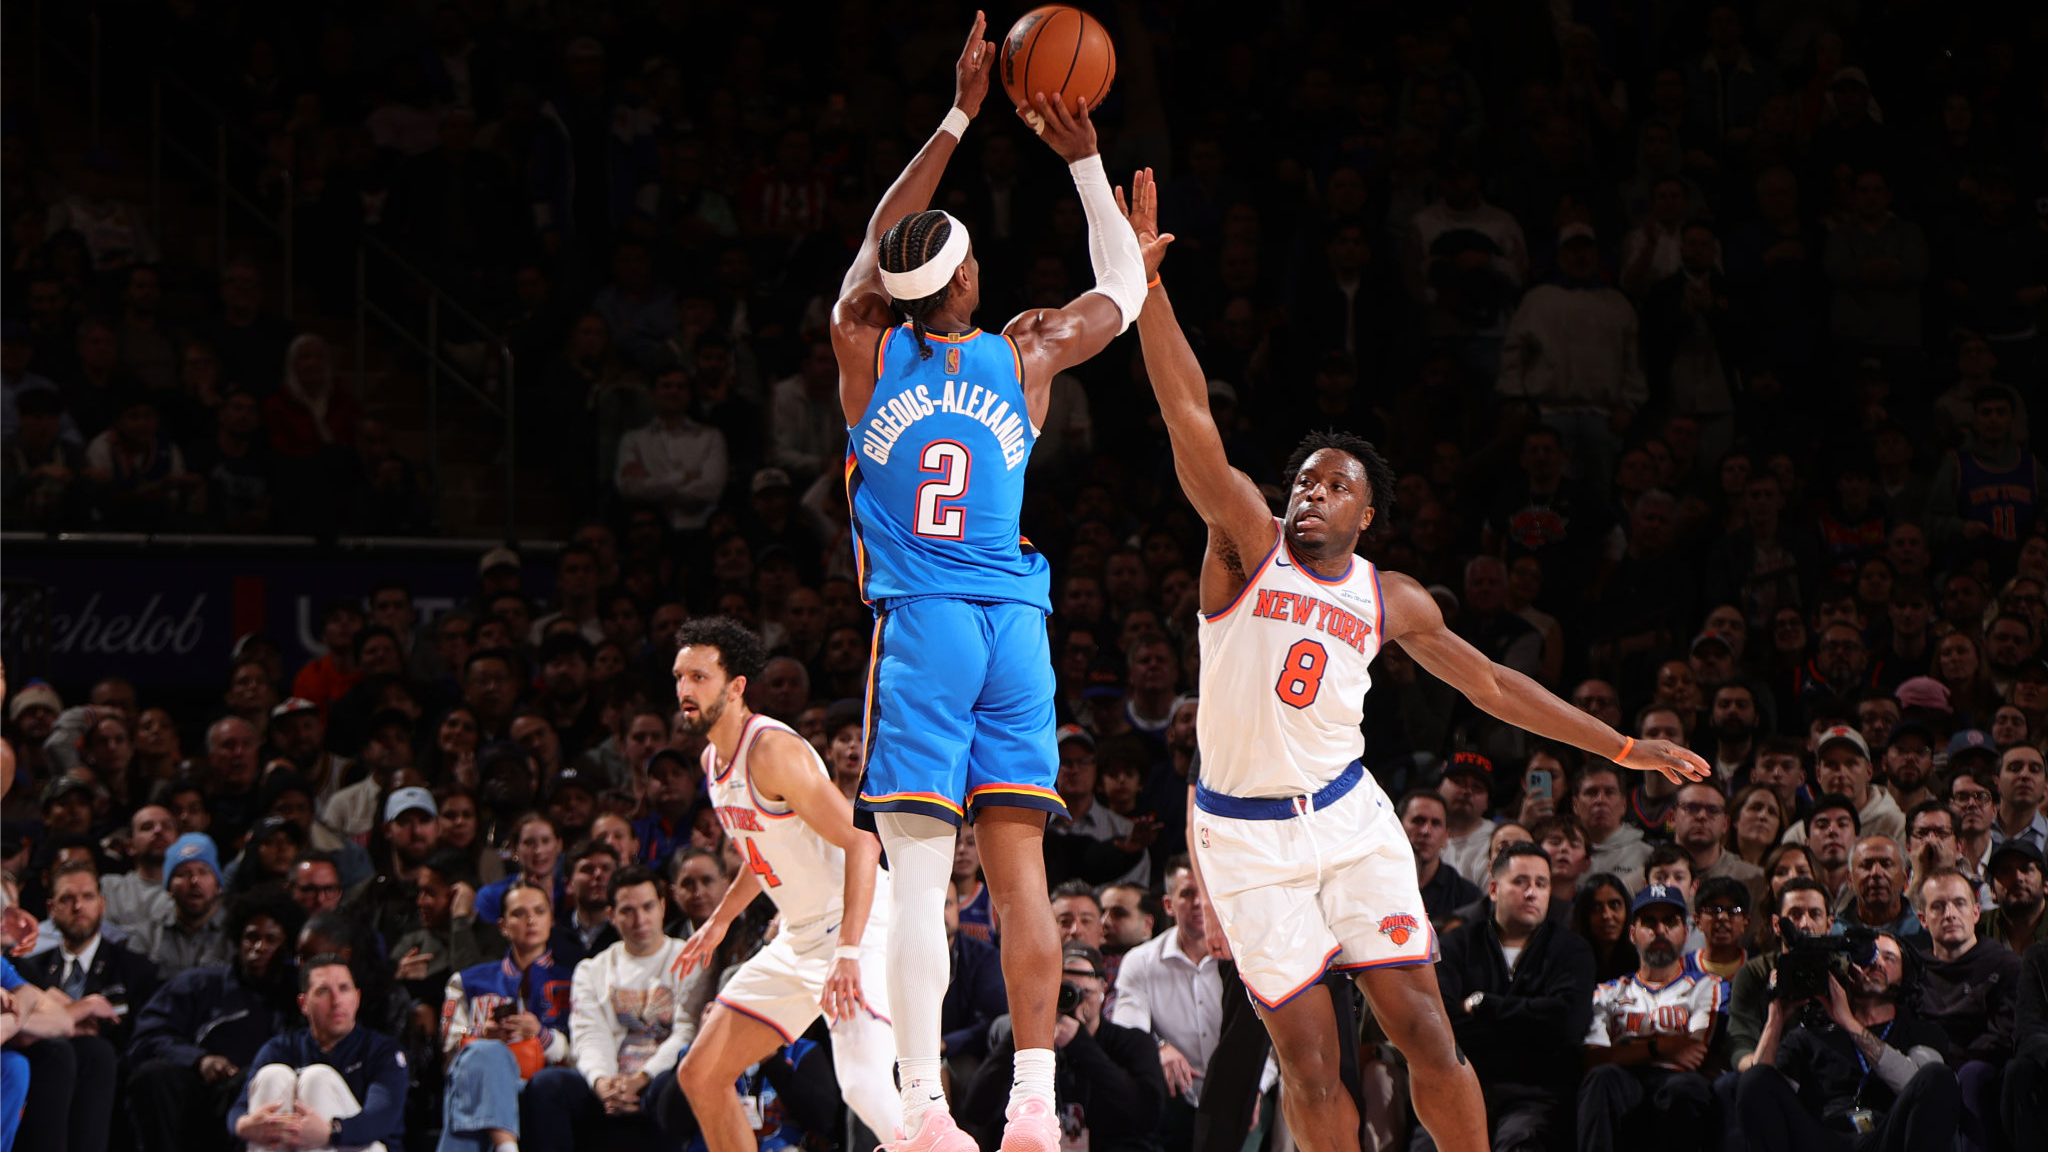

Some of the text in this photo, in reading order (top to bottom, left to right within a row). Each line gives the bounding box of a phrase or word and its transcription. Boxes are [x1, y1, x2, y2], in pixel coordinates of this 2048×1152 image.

[863, 380, 1025, 471] GILGEOUS-ALEXANDER
[913, 439, 972, 541] 2
[0, 590, 208, 655] chelob
[1253, 588, 1372, 655] NEW YORK
[1275, 638, 1328, 709] 8
[733, 837, 782, 888] 4
[1379, 914, 1419, 932] KNICKS
